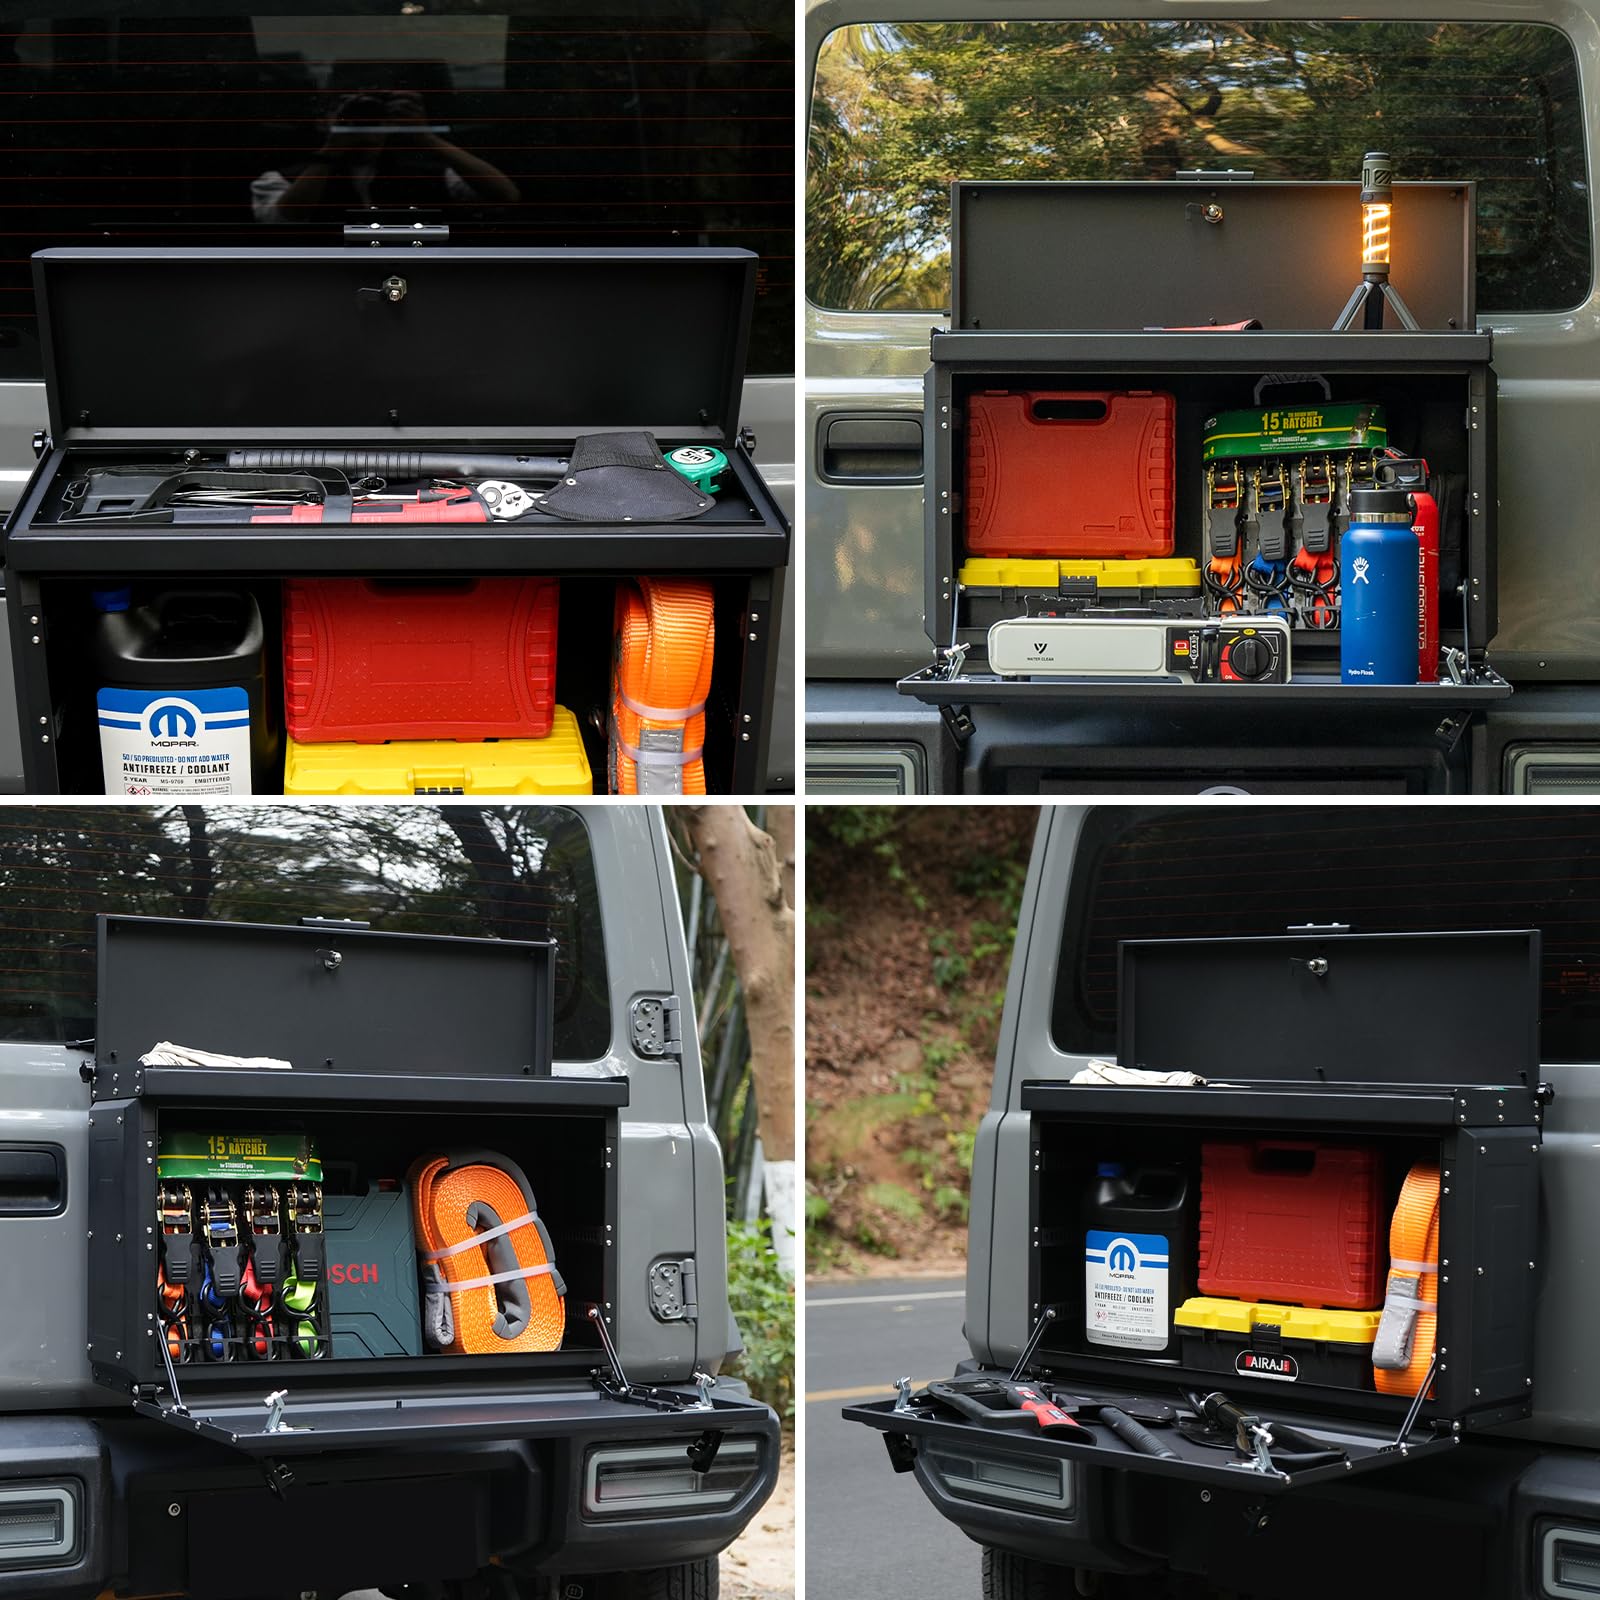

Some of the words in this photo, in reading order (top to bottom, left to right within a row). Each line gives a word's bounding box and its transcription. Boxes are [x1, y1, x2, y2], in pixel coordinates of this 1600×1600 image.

[1283, 415, 1323, 429] RATCHET
[123, 763, 177, 774] ANTIFREEZE
[188, 763, 230, 774] COOLANT
[229, 1143, 267, 1155] RATCHET
[327, 1263, 378, 1285] SCH
[1095, 1291, 1122, 1301] ANTIFREEZE
[1128, 1295, 1154, 1304] COOLANT
[1250, 1356, 1284, 1371] AIRAJ
